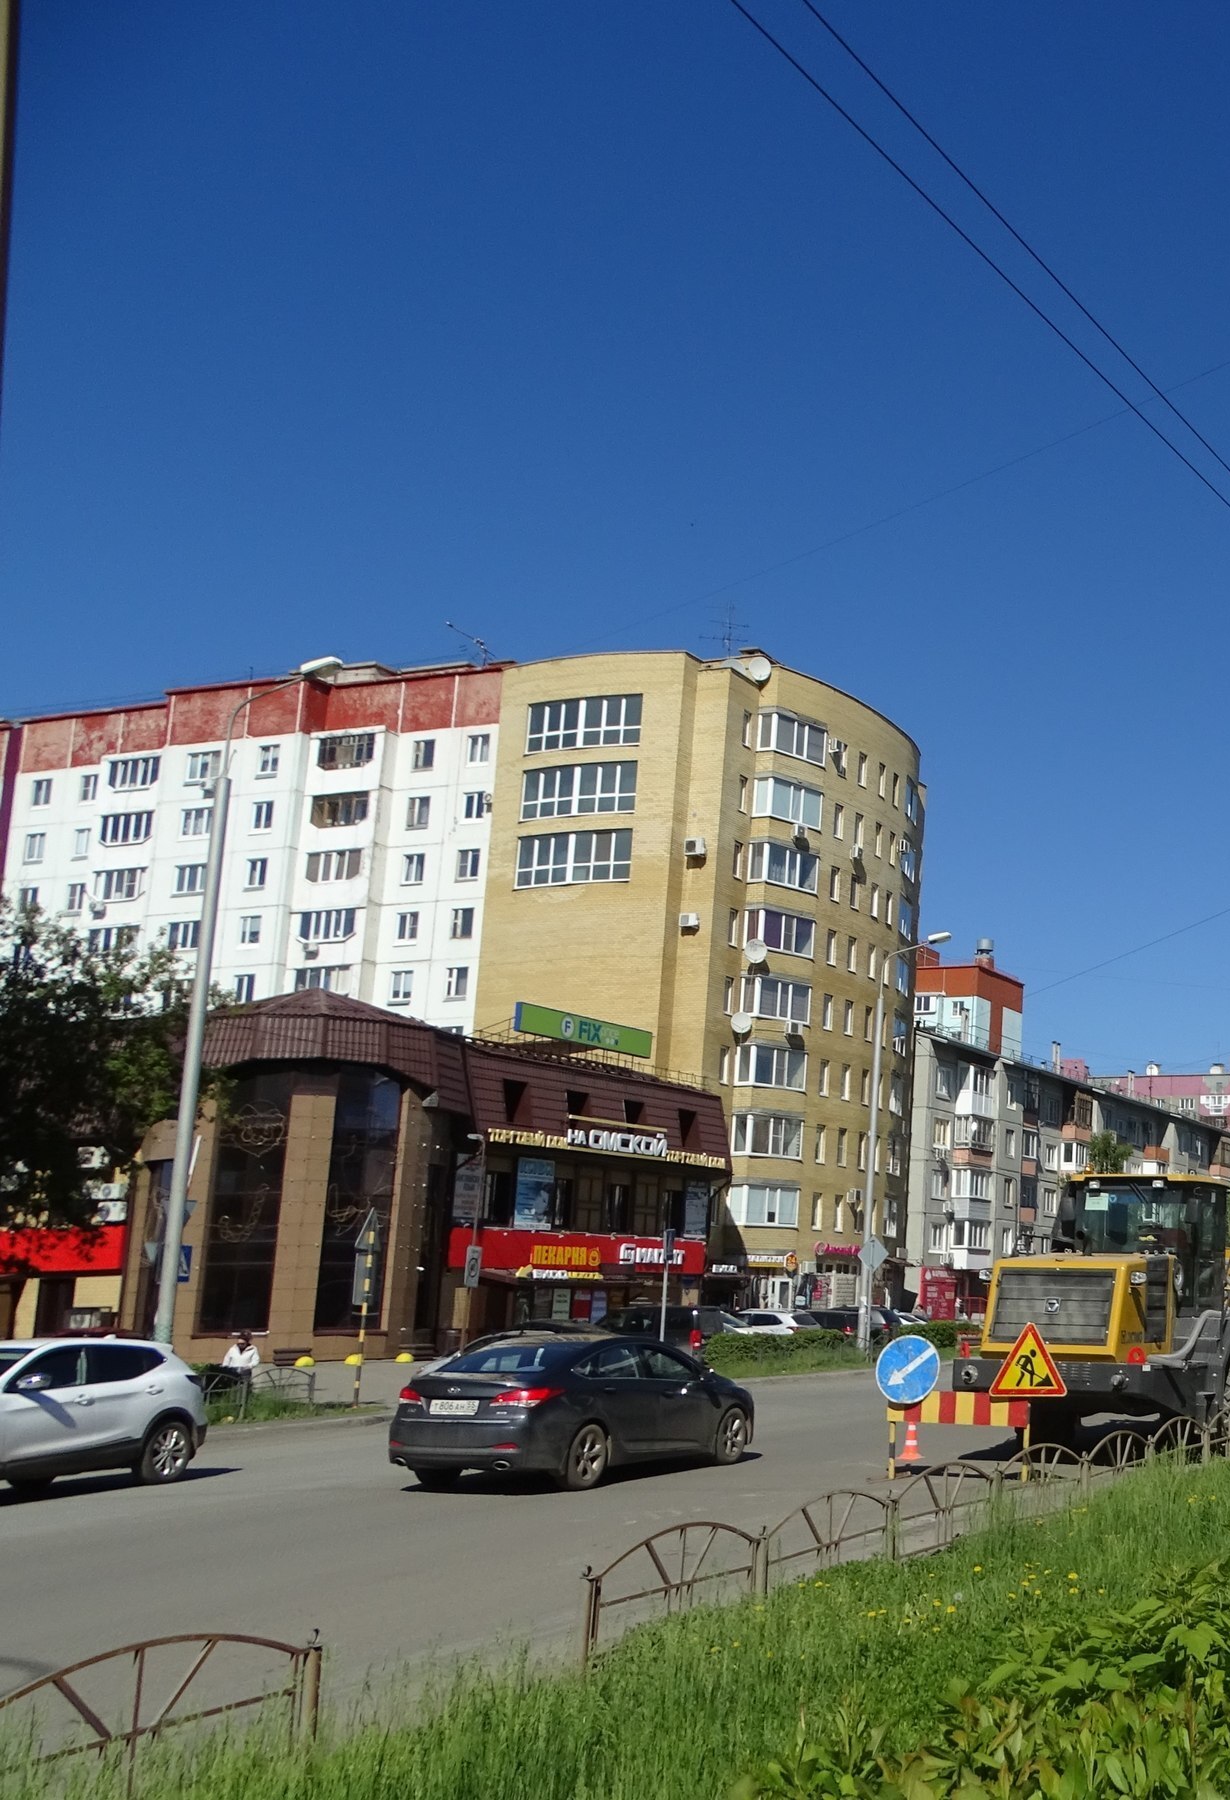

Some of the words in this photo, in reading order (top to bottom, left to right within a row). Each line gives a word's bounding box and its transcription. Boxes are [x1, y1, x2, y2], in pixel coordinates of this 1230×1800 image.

[568, 1128, 587, 1145] НА
[589, 1129, 668, 1157] ОМСКОЙ
[533, 1245, 587, 1265] ПЕКАРНЯ
